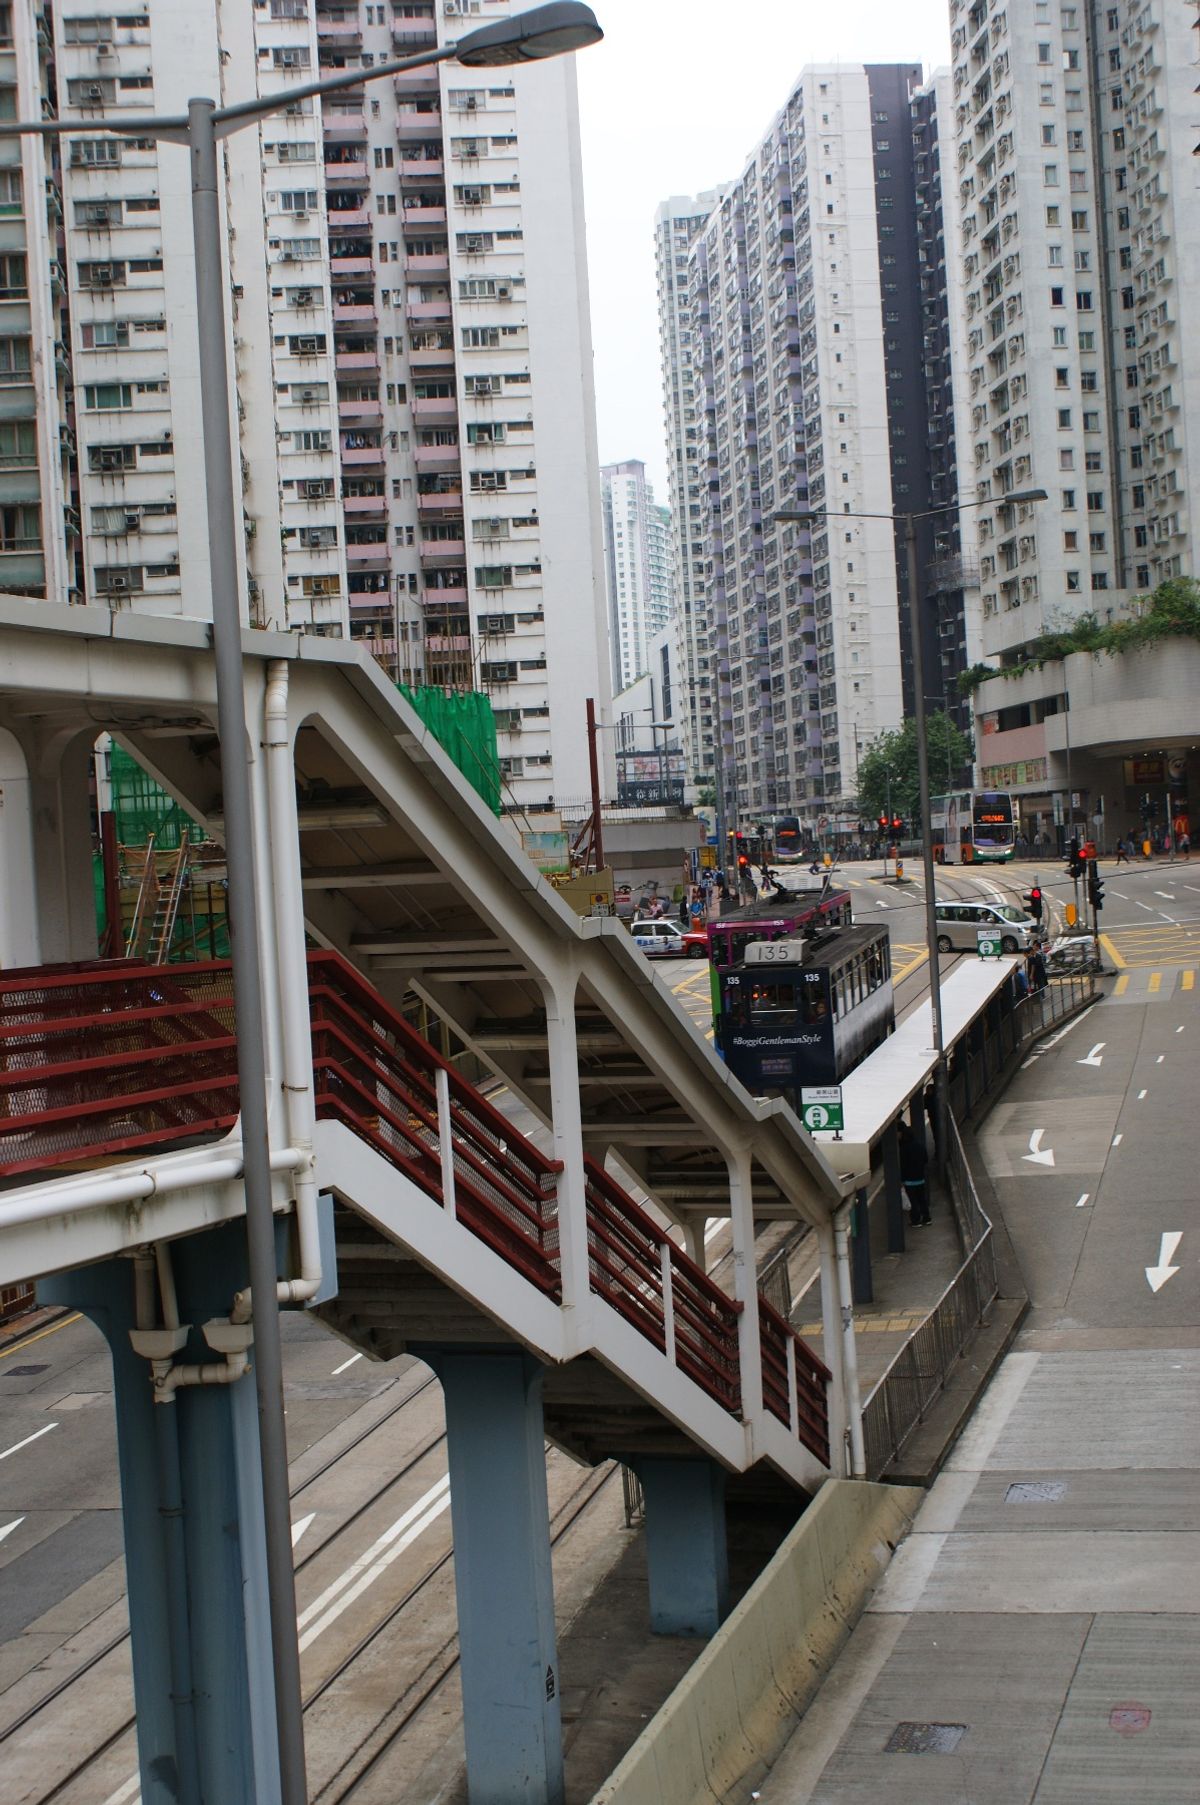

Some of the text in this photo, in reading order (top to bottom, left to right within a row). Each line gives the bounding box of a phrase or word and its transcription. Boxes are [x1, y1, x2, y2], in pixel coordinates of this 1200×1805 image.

[758, 945, 789, 961] 135
[727, 976, 740, 985] 135
[804, 973, 820, 982] 135
[733, 1034, 822, 1047] #BoggiGentlemanStyle
